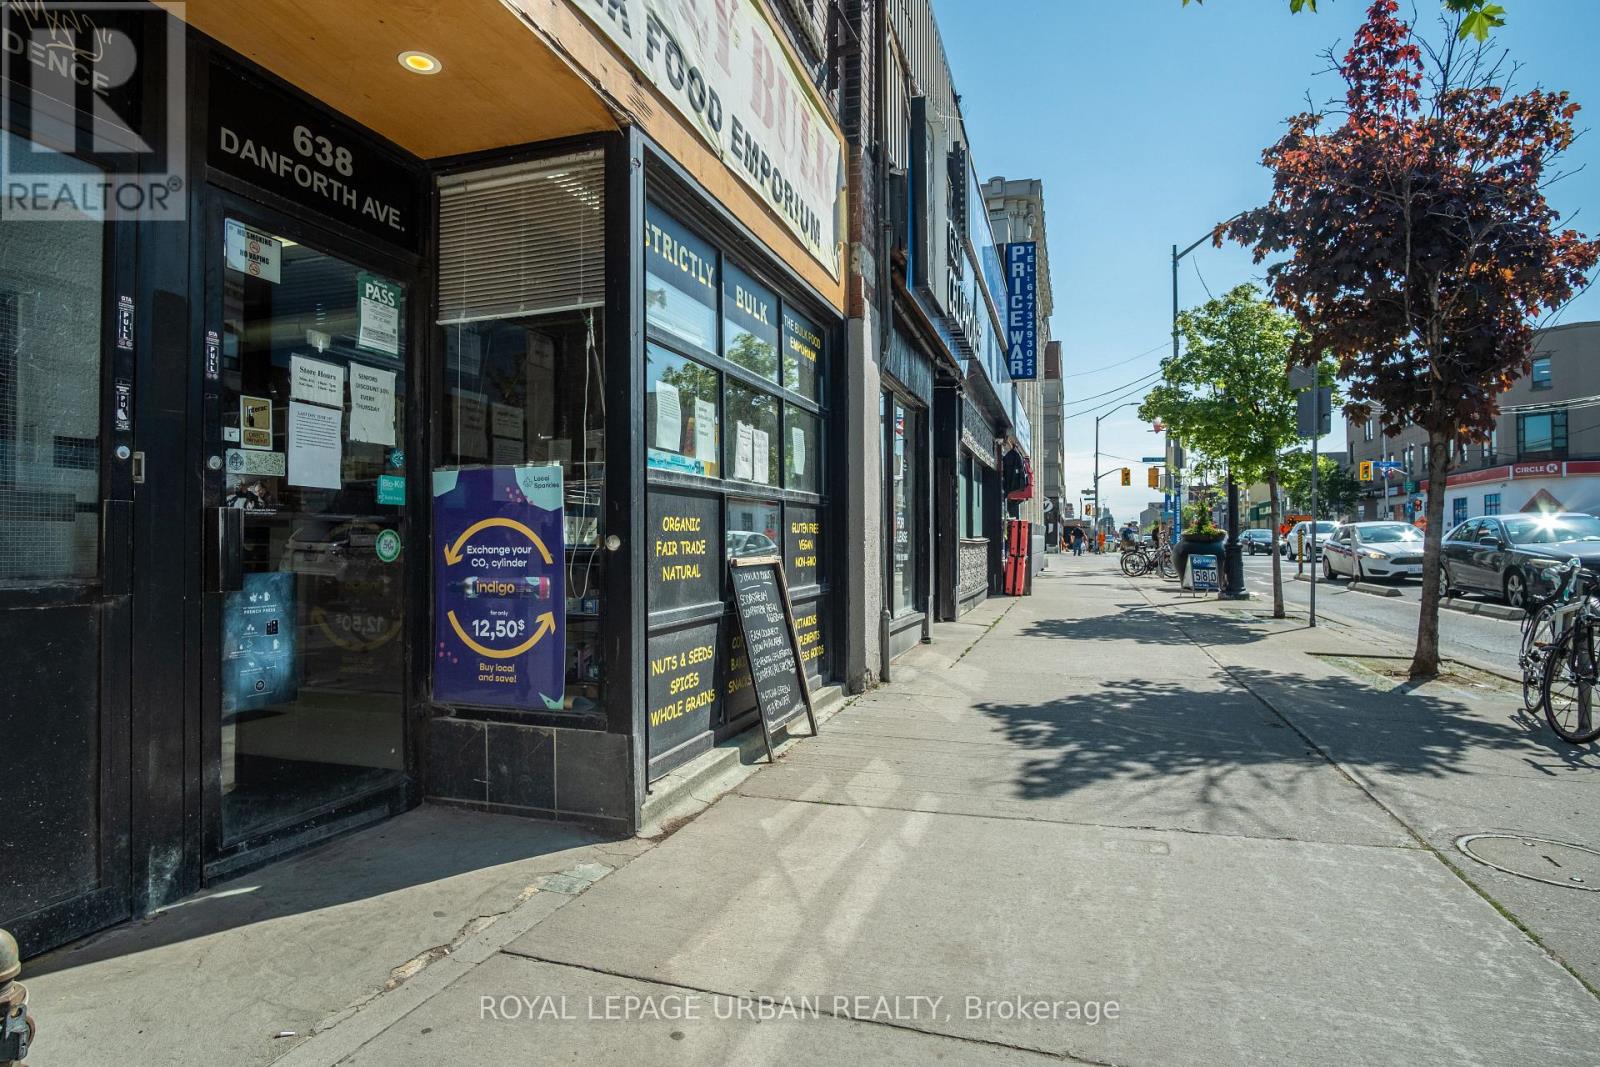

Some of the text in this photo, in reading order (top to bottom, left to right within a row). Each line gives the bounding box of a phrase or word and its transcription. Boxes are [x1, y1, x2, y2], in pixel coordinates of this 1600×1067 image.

[646, 13, 723, 133] FOOD
[731, 114, 821, 252] EMPORIUM
[293, 125, 354, 177] 638
[219, 126, 406, 232] DANFORTH AVE.
[237, 228, 273, 247] NO SMOKING
[239, 249, 270, 265] NO VAPING
[645, 218, 768, 325] STRICTLY BULK
[365, 282, 395, 307] PASS
[1010, 245, 1025, 375] PRICE WAR
[783, 314, 795, 331] THE
[808, 331, 821, 349] FOOD
[789, 336, 817, 363] EMPORIUM
[299, 365, 337, 381] Store Hours
[358, 373, 378, 382] SENIORS
[355, 383, 379, 393] DISCOUNT
[360, 394, 375, 402] EVERY
[355, 403, 380, 412] THURSDAY
[1515, 463, 1558, 474] CIRCLE K
[662, 516, 701, 532] ORGANIC
[791, 522, 809, 534] GLUTEN
[466, 545, 532, 556] Exchange your
[656, 539, 706, 557] FAIR TRADE
[798, 538, 814, 551] VEGAN
[491, 558, 527, 568] cylinder
[795, 555, 817, 569] NON-GMO
[662, 564, 701, 582] NATURAL
[476, 581, 515, 595] indigo
[795, 614, 817, 630] VITAMINS
[798, 630, 821, 646] PLEMENTS
[479, 663, 515, 673] Buy local
[651, 657, 678, 677] NUTS
[680, 656, 686, 667] &
[688, 645, 713, 665] SEEDS
[478, 674, 517, 683] and save!
[670, 672, 699, 696] SPICES
[650, 688, 716, 728] WHOLE GRAINS
